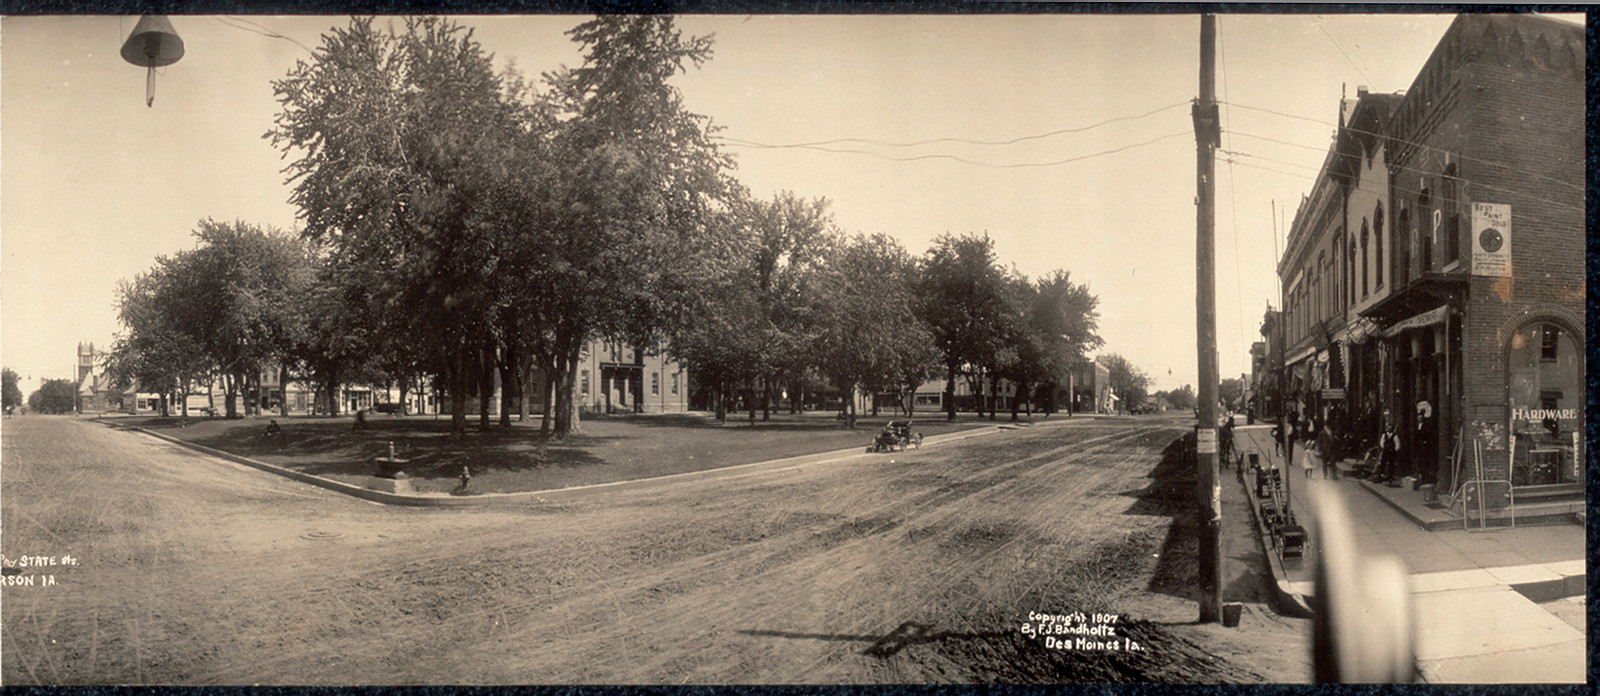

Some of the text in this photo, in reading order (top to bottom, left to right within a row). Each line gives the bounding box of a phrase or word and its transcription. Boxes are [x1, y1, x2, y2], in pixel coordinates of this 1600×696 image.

[1475, 203, 1492, 211] BEST
[1484, 211, 1502, 219] PAINT
[1433, 209, 1442, 244] P
